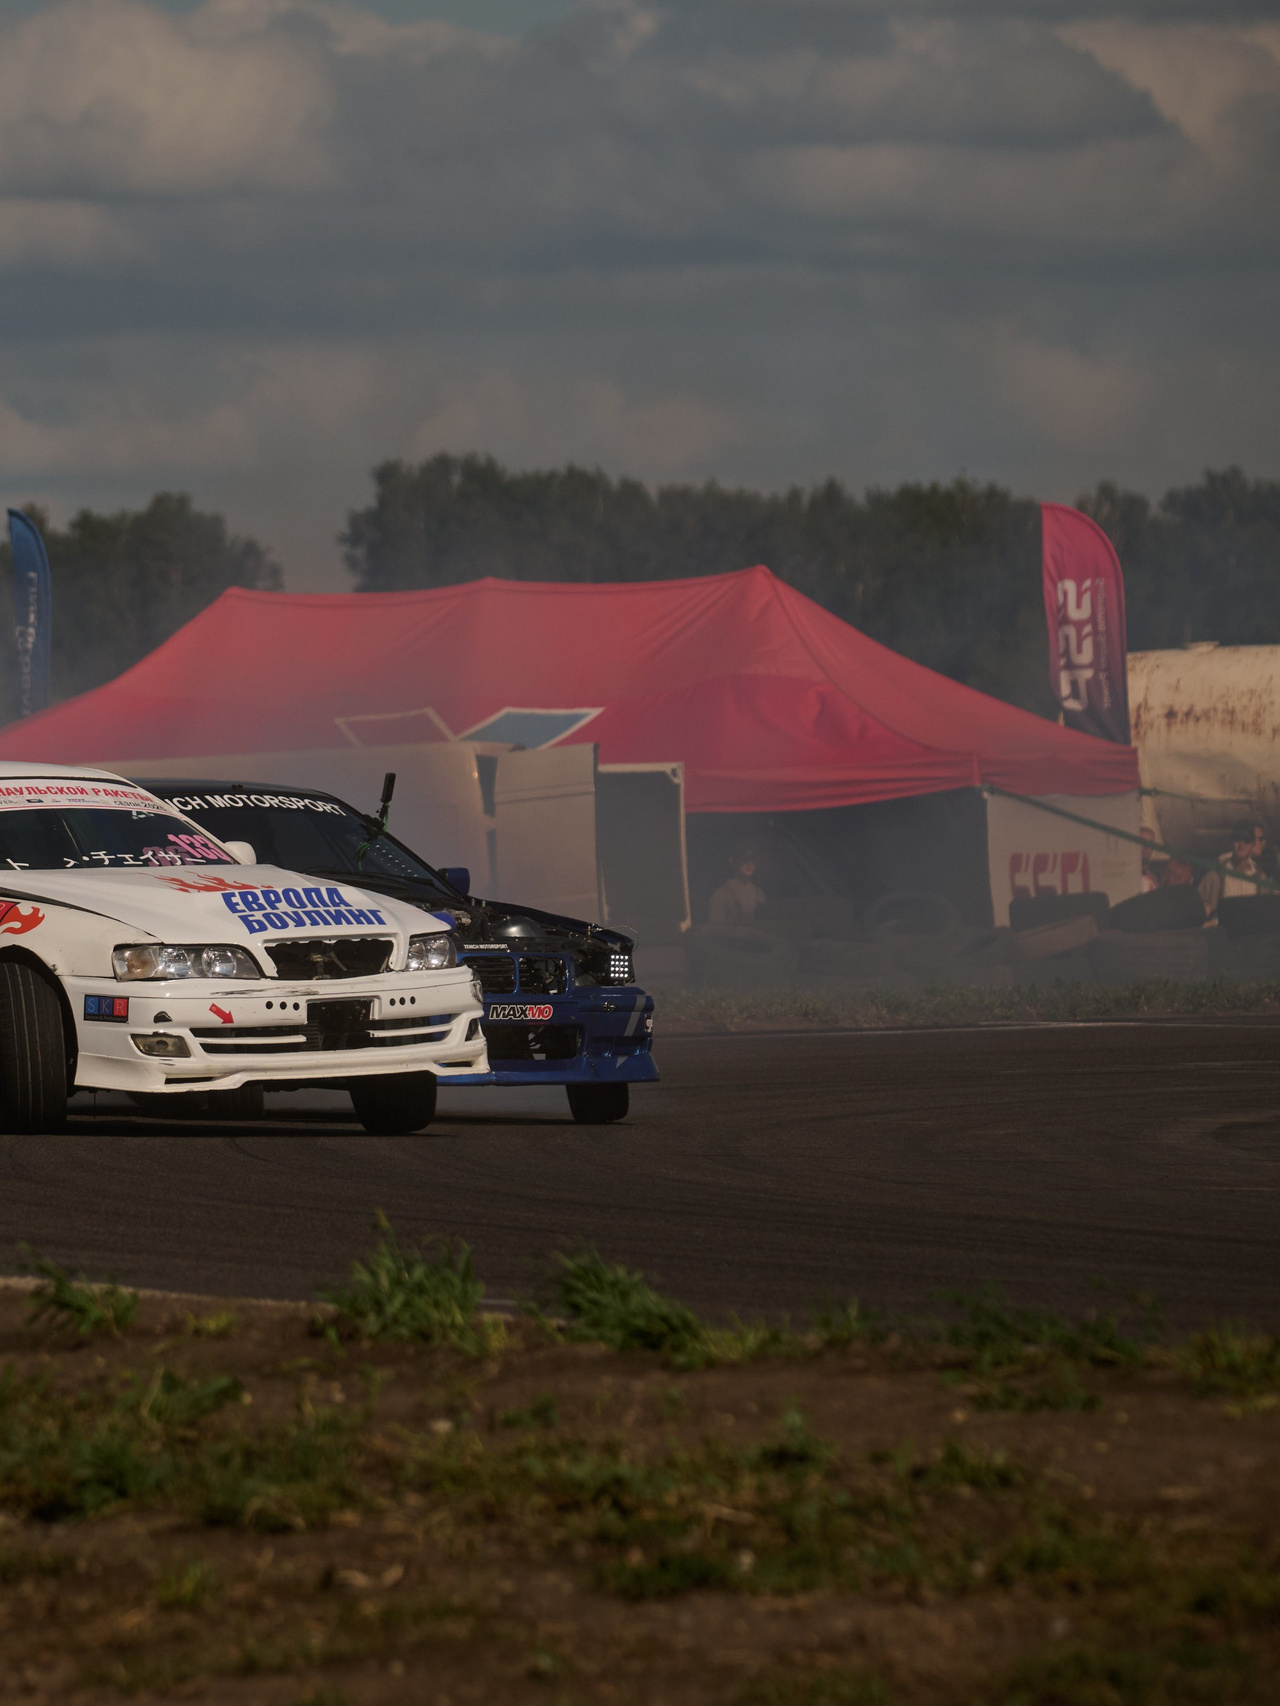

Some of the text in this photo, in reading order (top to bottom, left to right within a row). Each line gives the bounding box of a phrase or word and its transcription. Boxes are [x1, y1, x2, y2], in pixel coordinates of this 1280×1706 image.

[91, 787, 153, 802] РАКЕТЫ
[163, 794, 347, 817] ICH MOTORSPORT
[166, 834, 231, 862] 133
[221, 887, 353, 914] ЕВРОПА
[238, 909, 387, 934] БОУЛИНГ
[87, 998, 124, 1014] SKR
[489, 1004, 553, 1020] MAXMO
